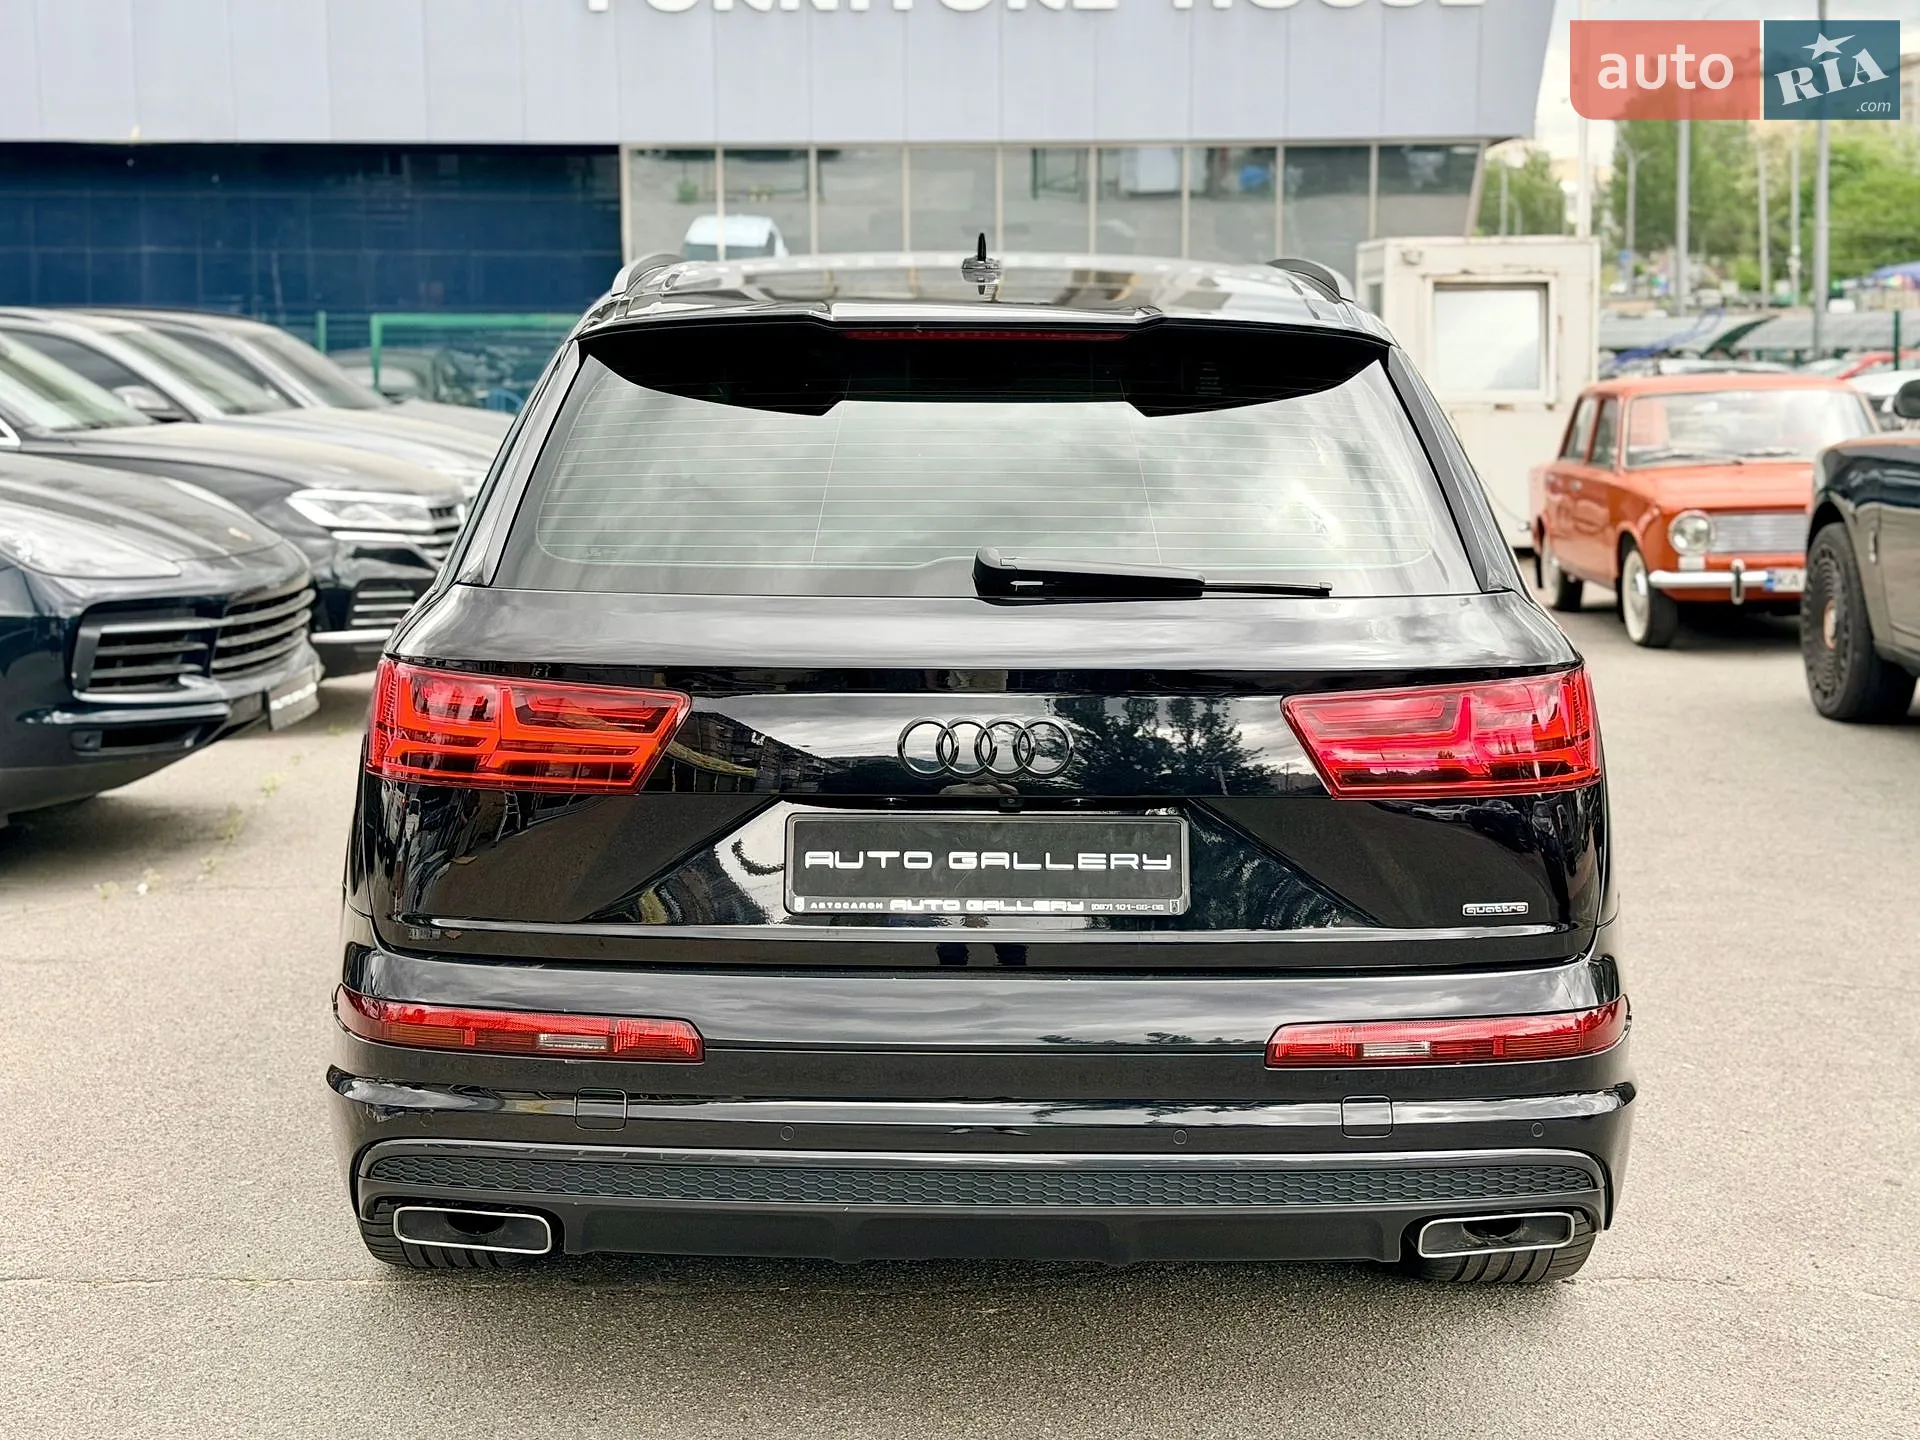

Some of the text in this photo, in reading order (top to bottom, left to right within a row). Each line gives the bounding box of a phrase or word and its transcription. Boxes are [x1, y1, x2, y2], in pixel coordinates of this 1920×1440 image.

[805, 851, 1172, 871] AUTO GALLERY
[889, 900, 961, 911] AUTO
[966, 900, 1085, 912] GALLERY
[1465, 904, 1526, 915] quattro
